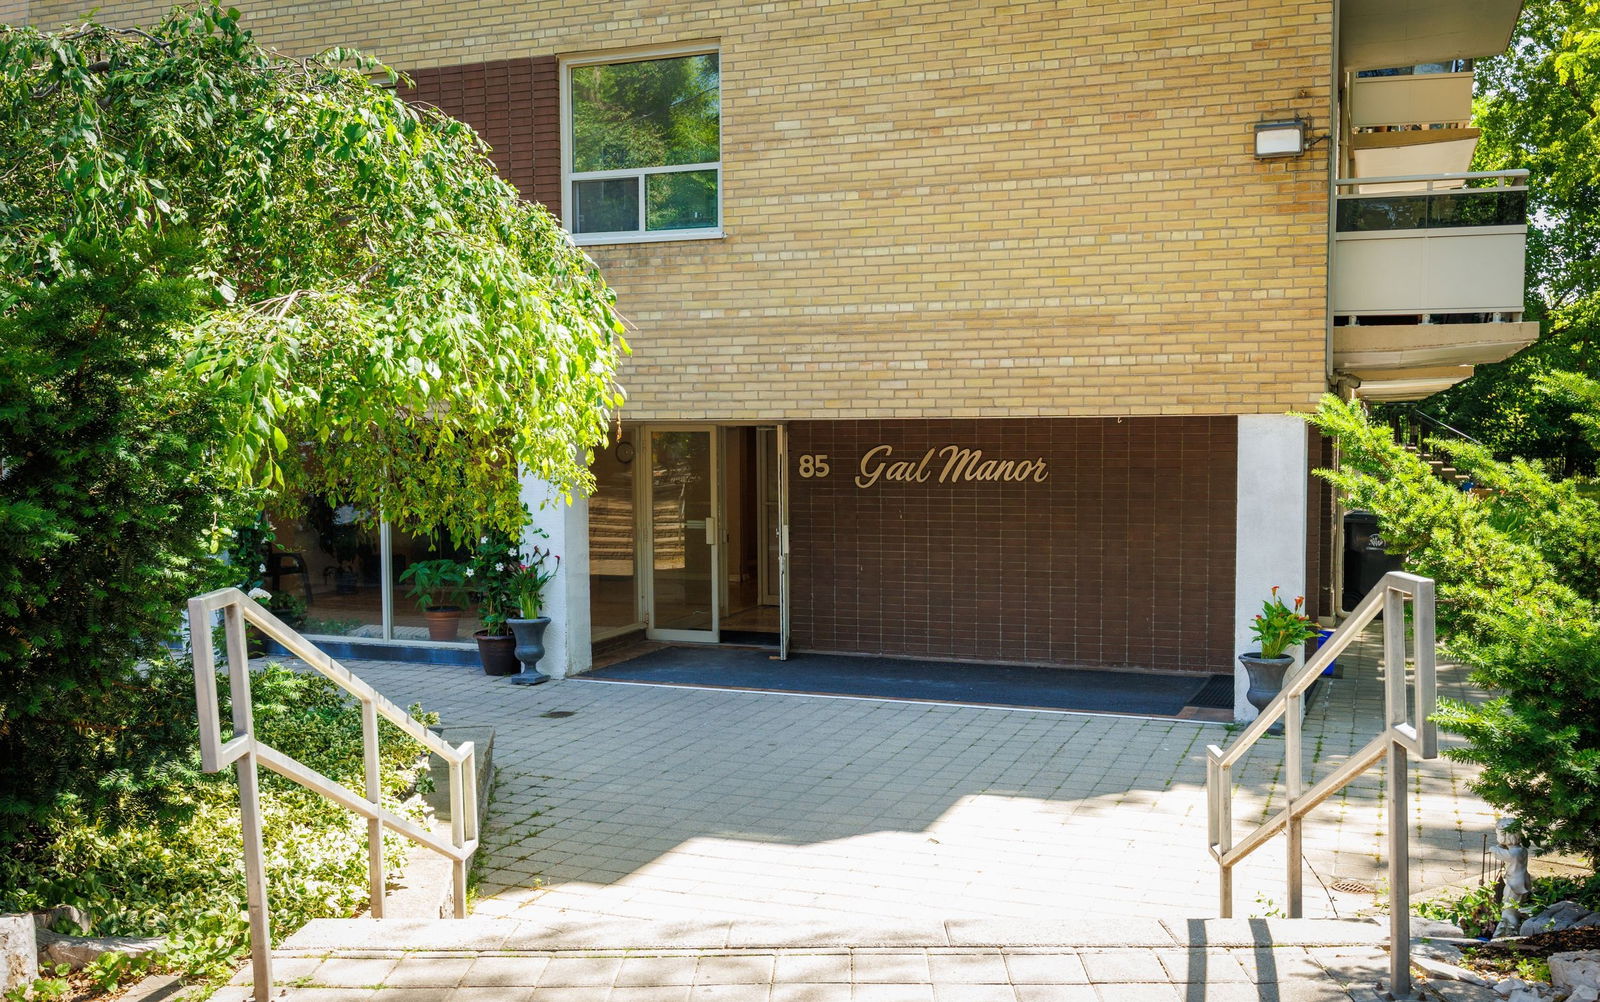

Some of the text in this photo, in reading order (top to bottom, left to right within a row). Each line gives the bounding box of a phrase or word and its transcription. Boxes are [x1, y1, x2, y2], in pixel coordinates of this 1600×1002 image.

[799, 454, 830, 478] 85
[854, 444, 1049, 489] Gail Manor
